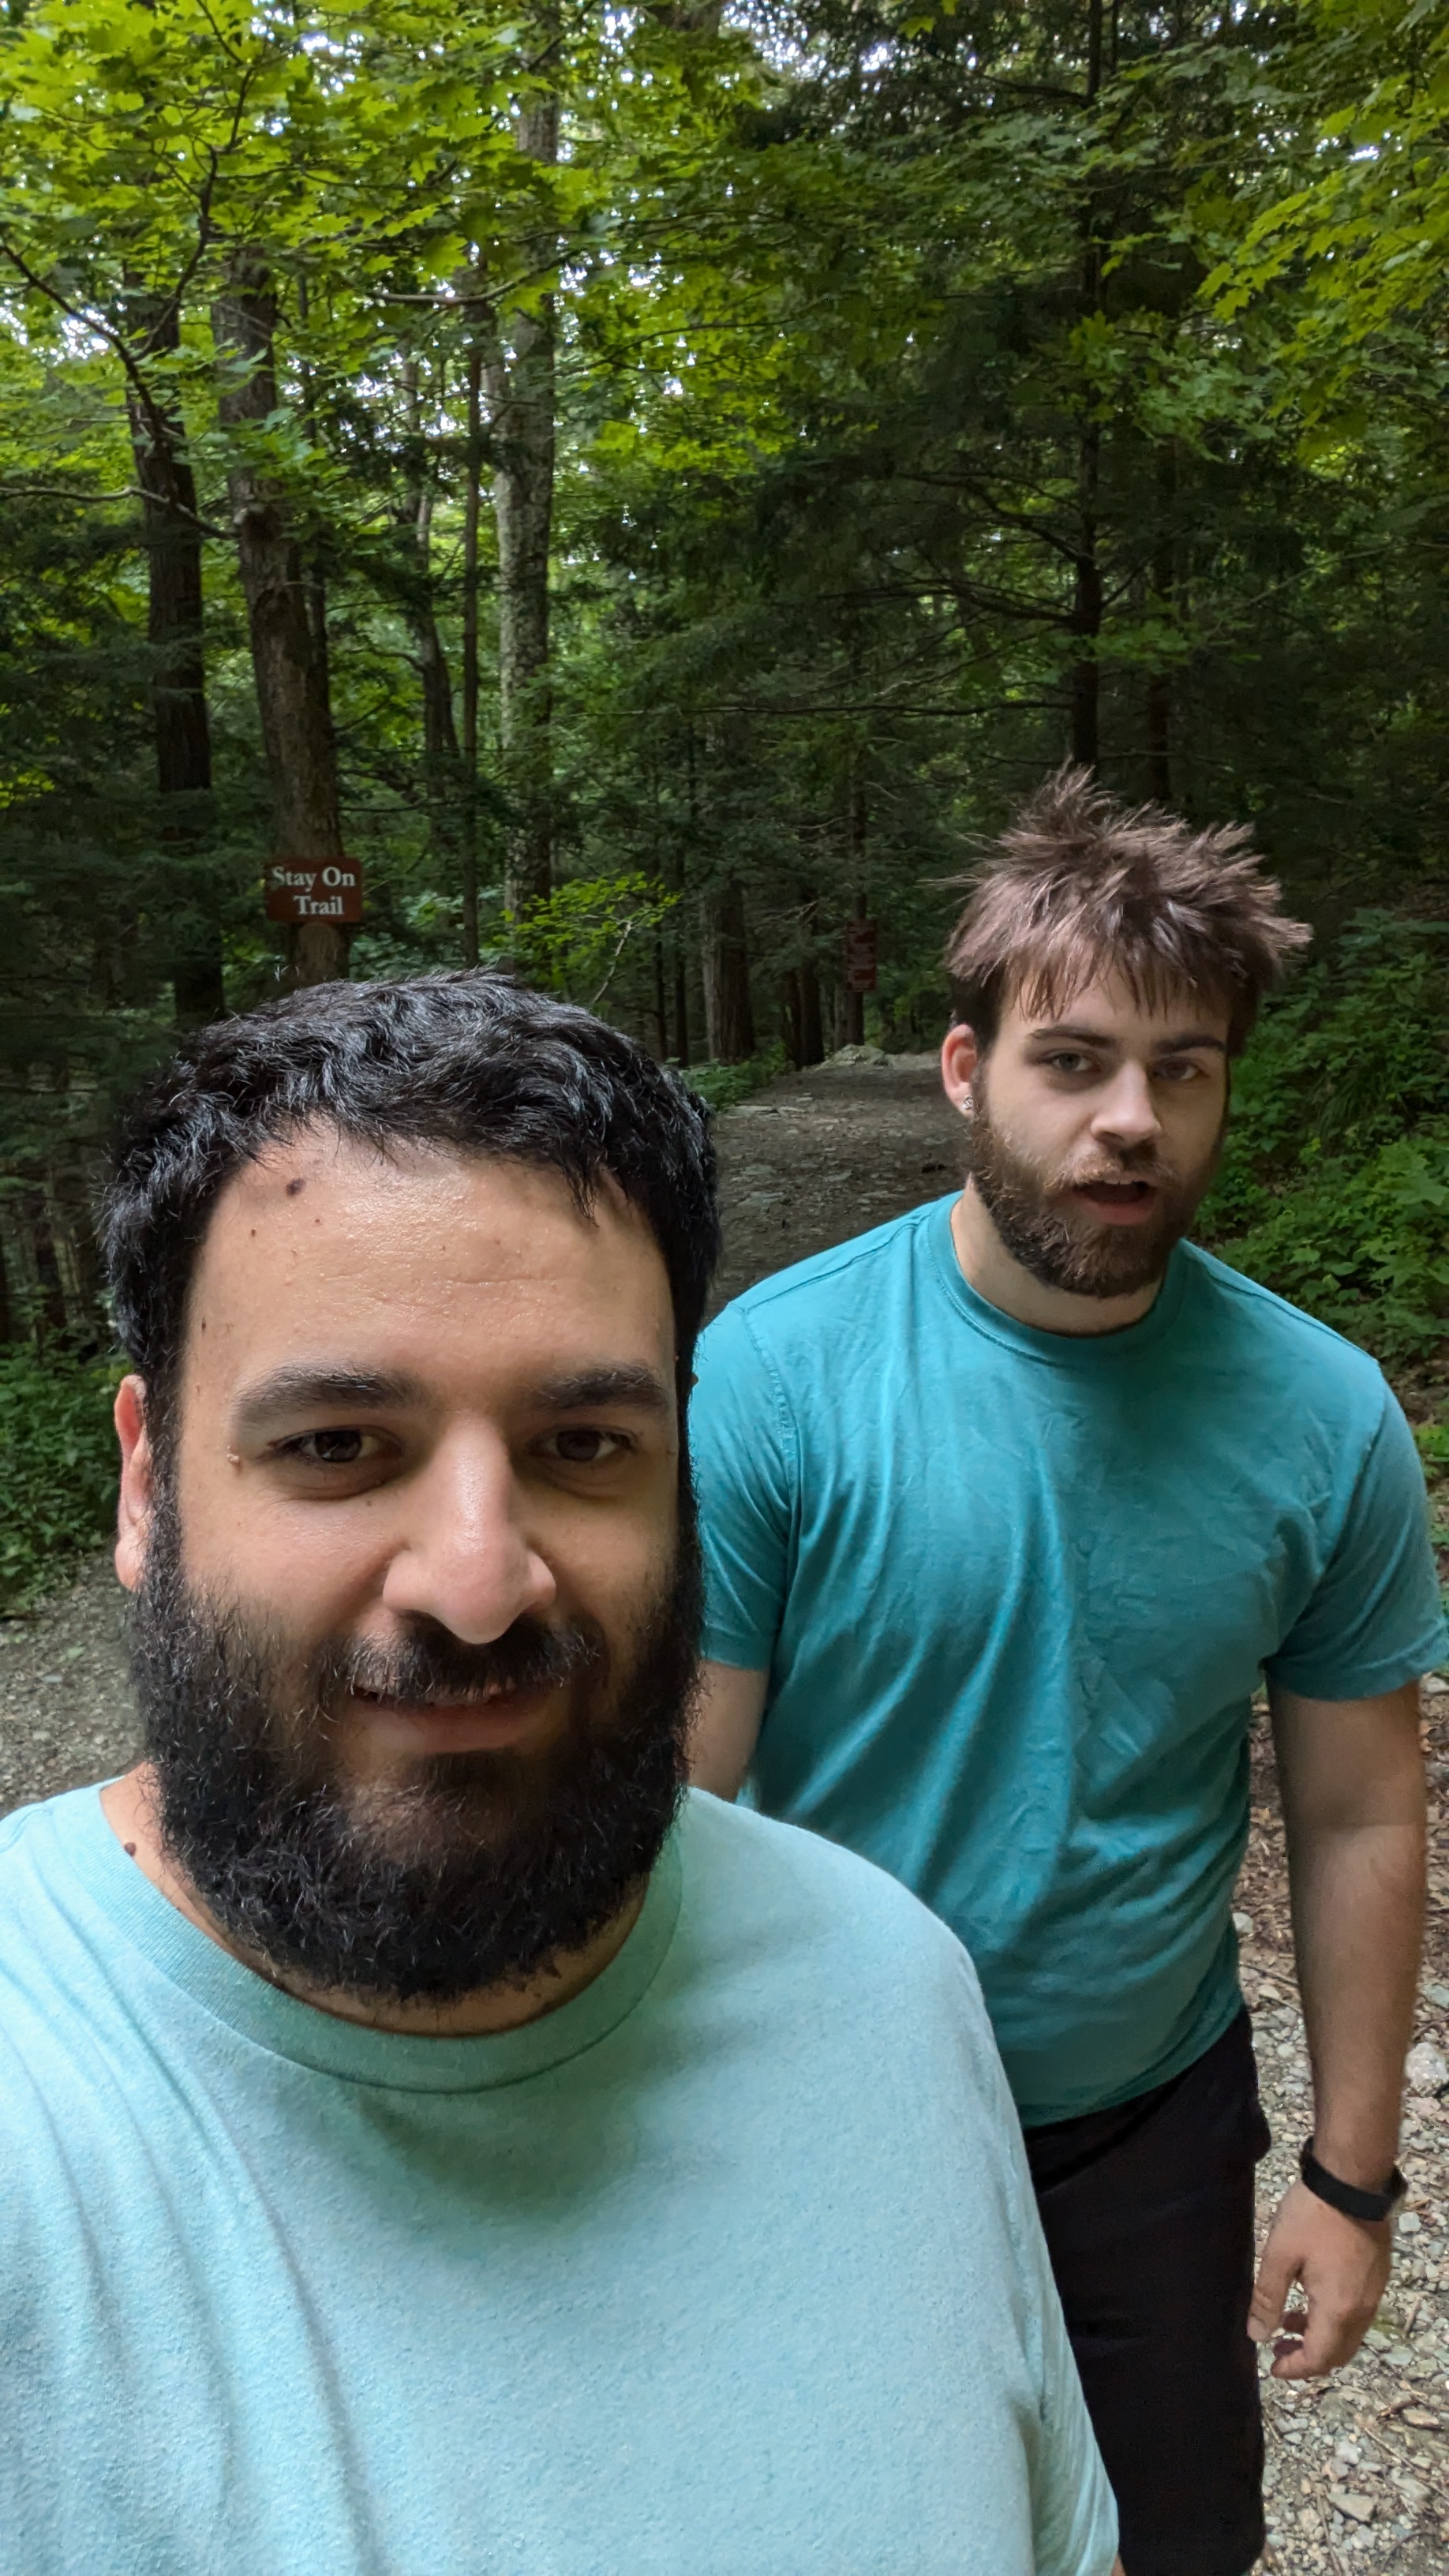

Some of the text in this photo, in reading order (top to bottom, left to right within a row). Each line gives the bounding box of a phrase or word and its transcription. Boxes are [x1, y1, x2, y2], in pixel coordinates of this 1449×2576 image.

[272, 866, 355, 892] Stay On
[293, 895, 343, 915] Trail
